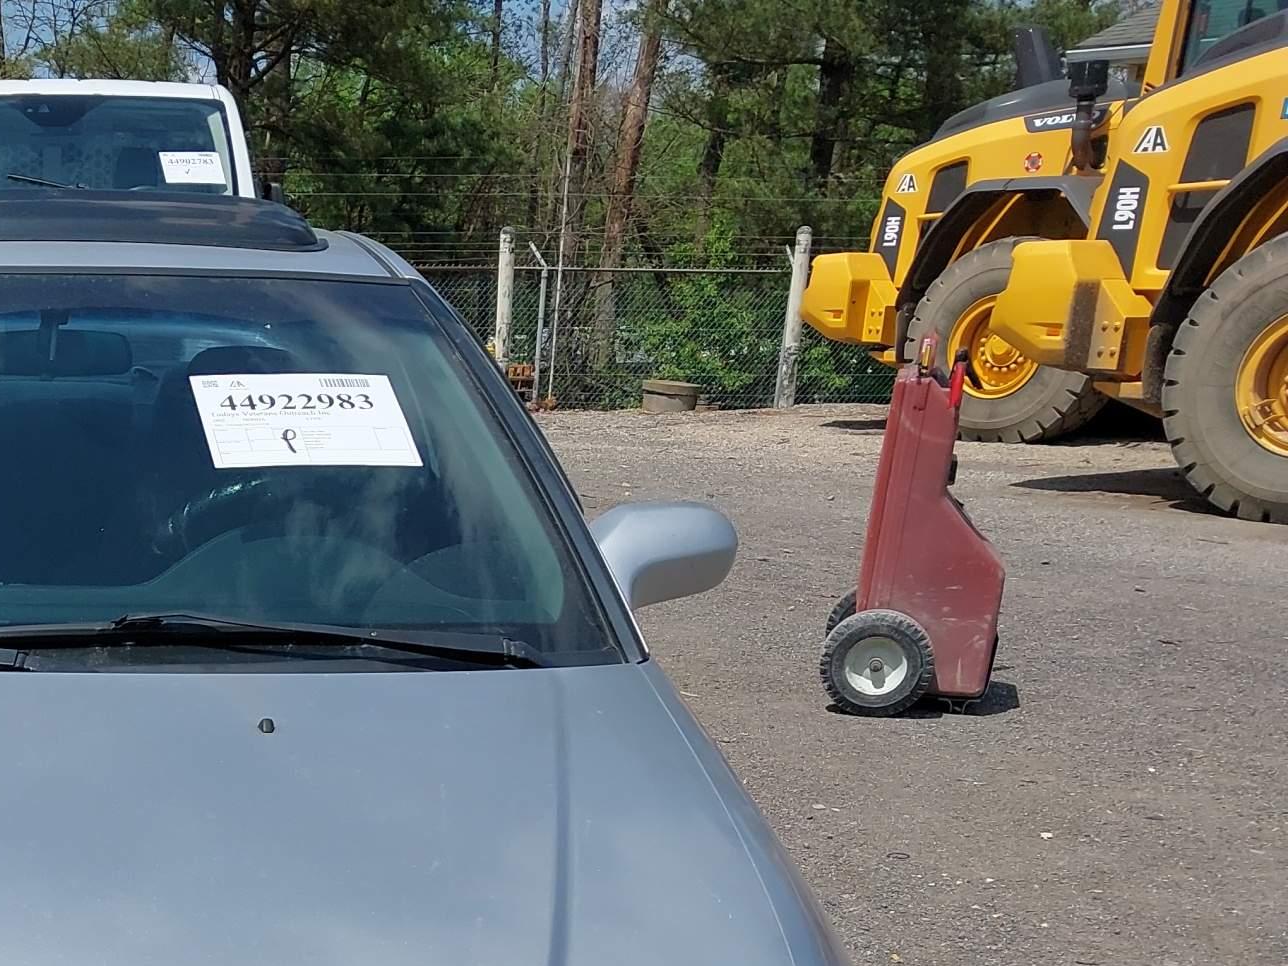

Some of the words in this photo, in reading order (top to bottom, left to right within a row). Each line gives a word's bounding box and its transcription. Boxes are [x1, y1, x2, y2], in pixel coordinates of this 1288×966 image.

[1112, 187, 1140, 230] L90H
[883, 216, 901, 247] L90H
[220, 393, 374, 411] 44922983
